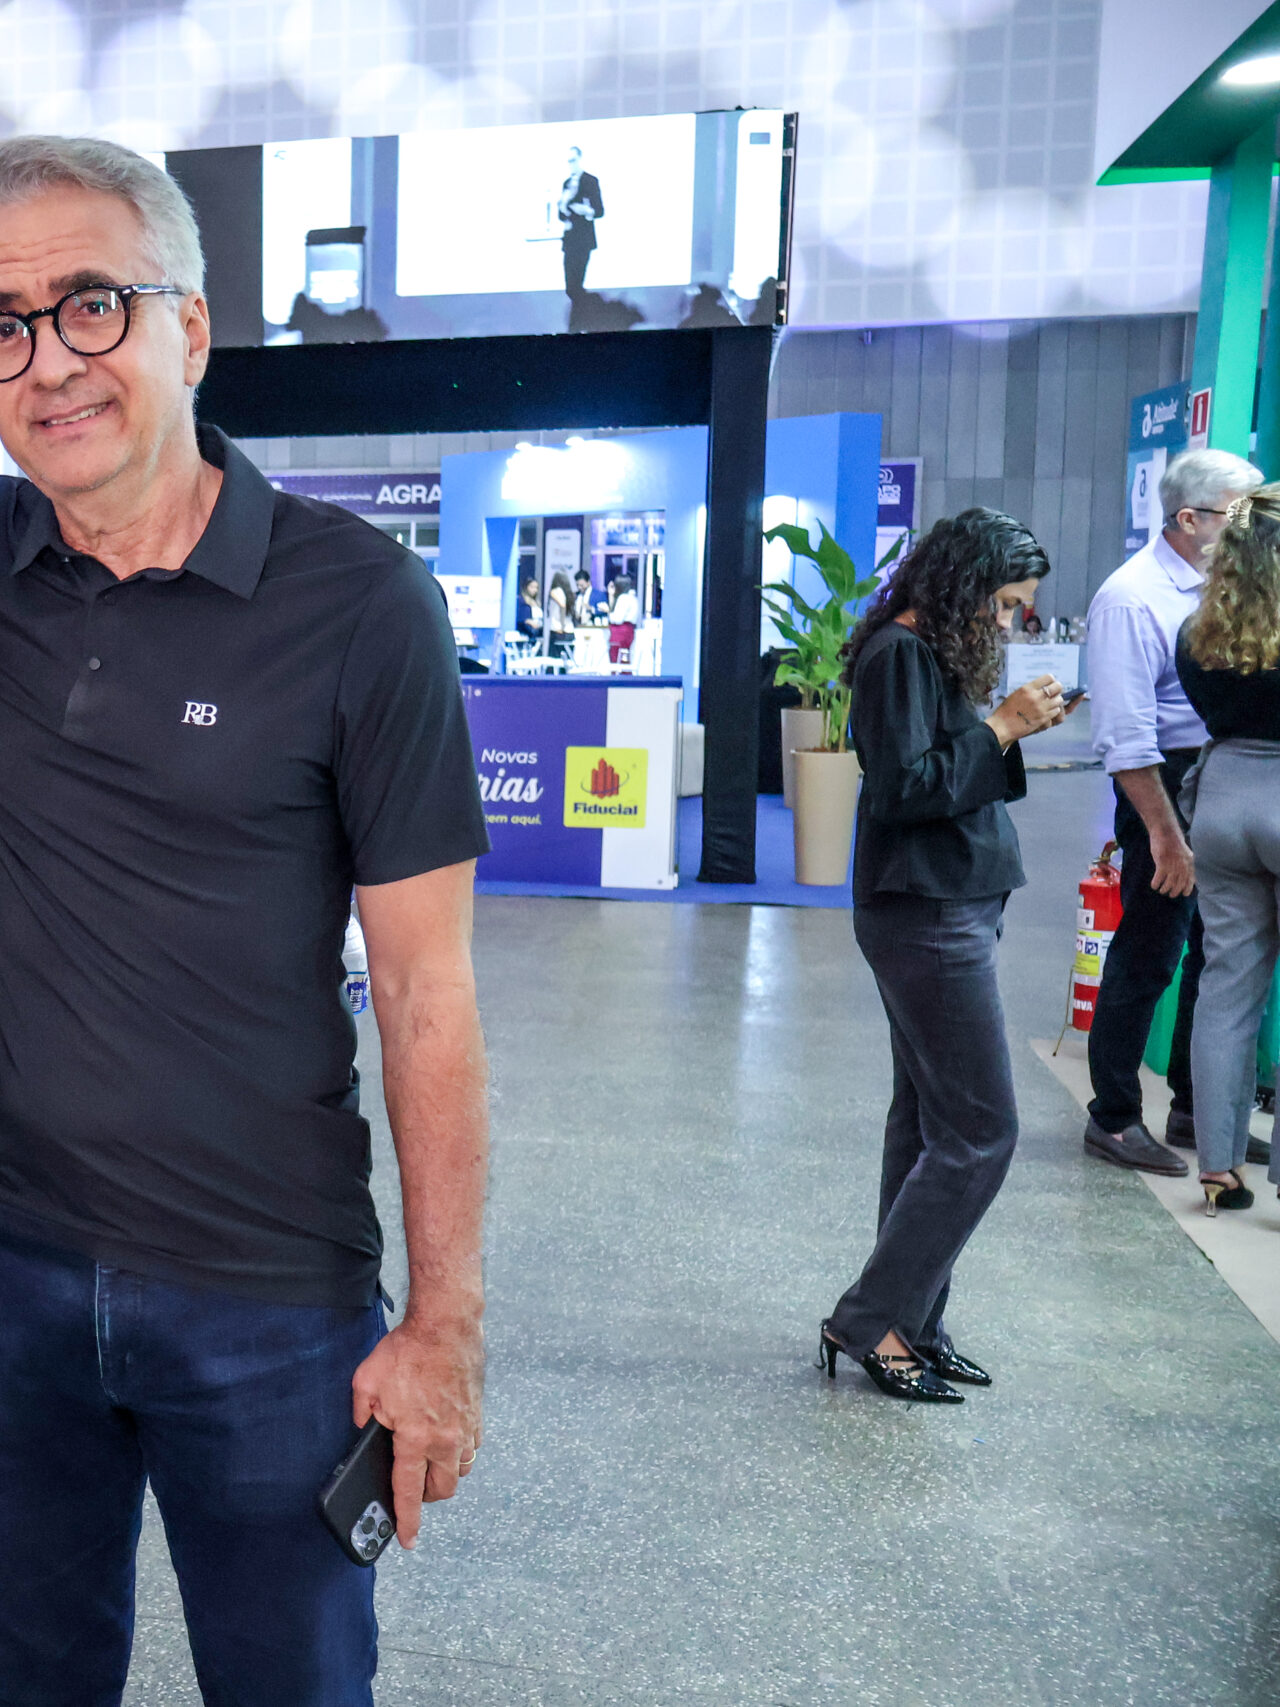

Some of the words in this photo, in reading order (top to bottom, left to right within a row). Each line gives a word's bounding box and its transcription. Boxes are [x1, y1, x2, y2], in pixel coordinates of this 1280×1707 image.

[375, 484, 442, 505] AGRA
[481, 749, 538, 764] Novas
[573, 802, 638, 816] Fiducial
